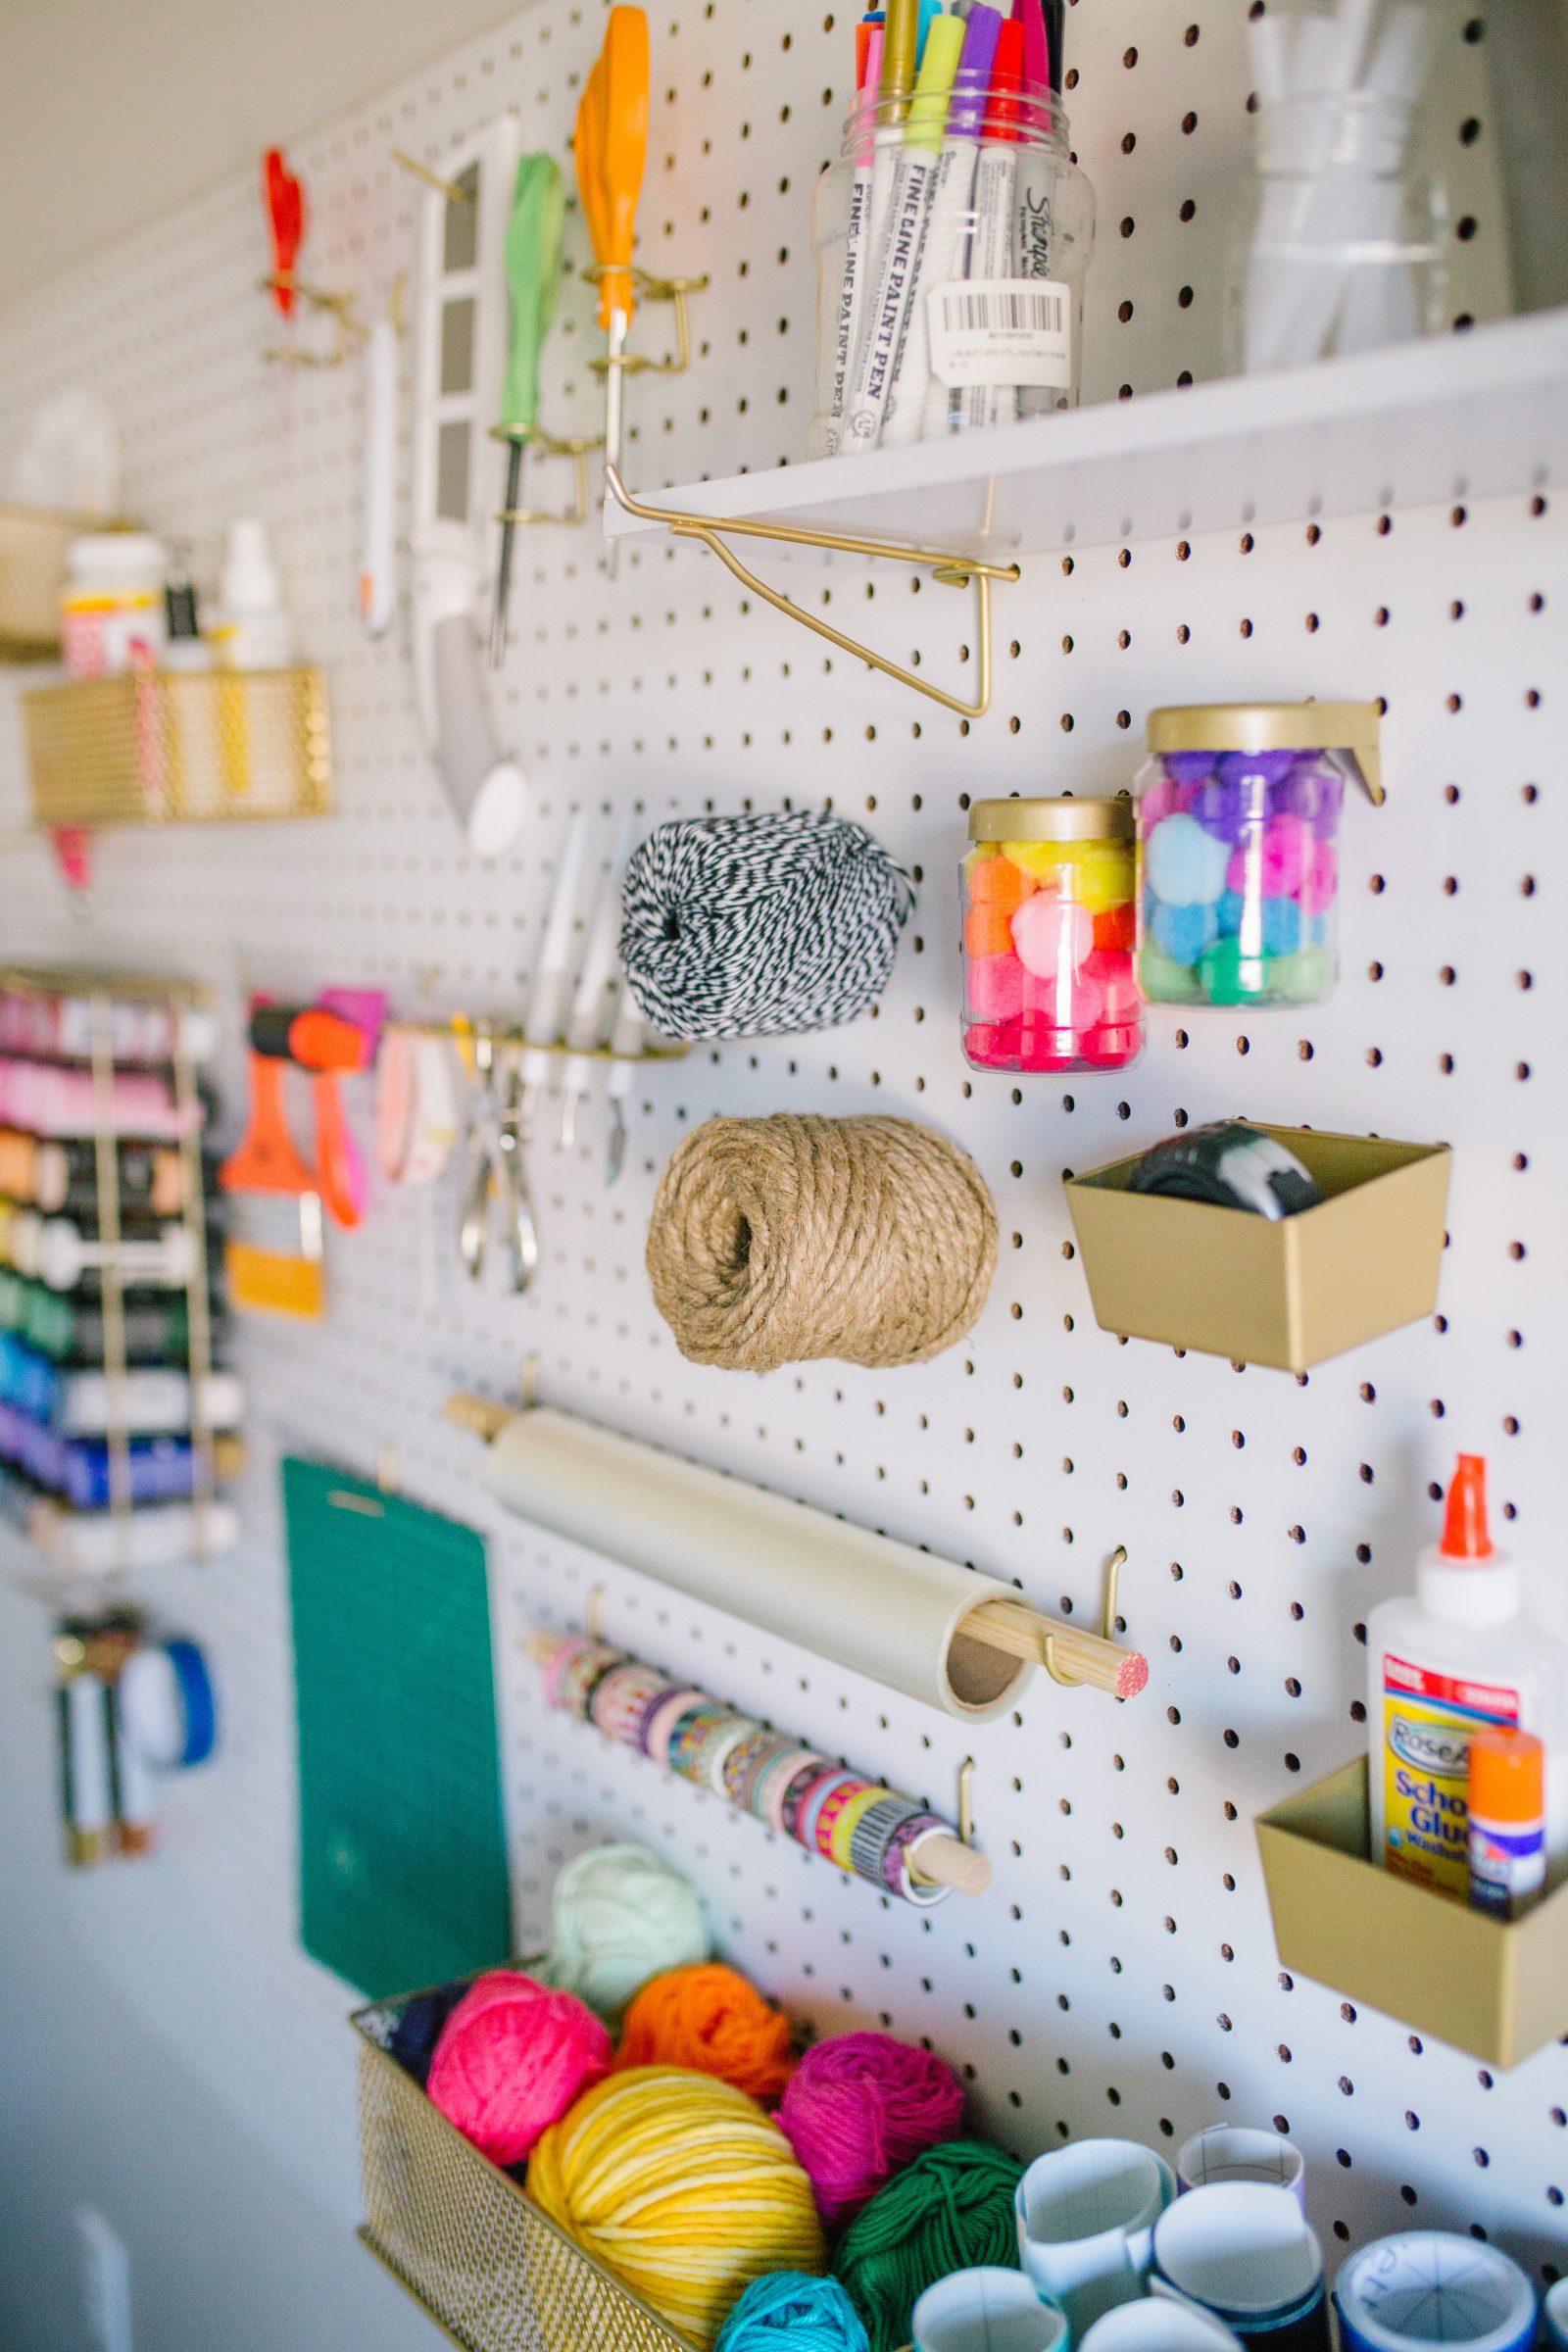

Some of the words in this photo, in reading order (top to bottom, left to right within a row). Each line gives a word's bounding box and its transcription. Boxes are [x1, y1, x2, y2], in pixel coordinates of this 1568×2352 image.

[849, 183, 863, 235] FINE
[904, 165, 926, 216] FINE
[844, 237, 858, 289] INE
[837, 293, 853, 367] PAINT
[878, 272, 905, 347] PAINT
[830, 371, 845, 418] PEN
[867, 351, 888, 401] PEN
